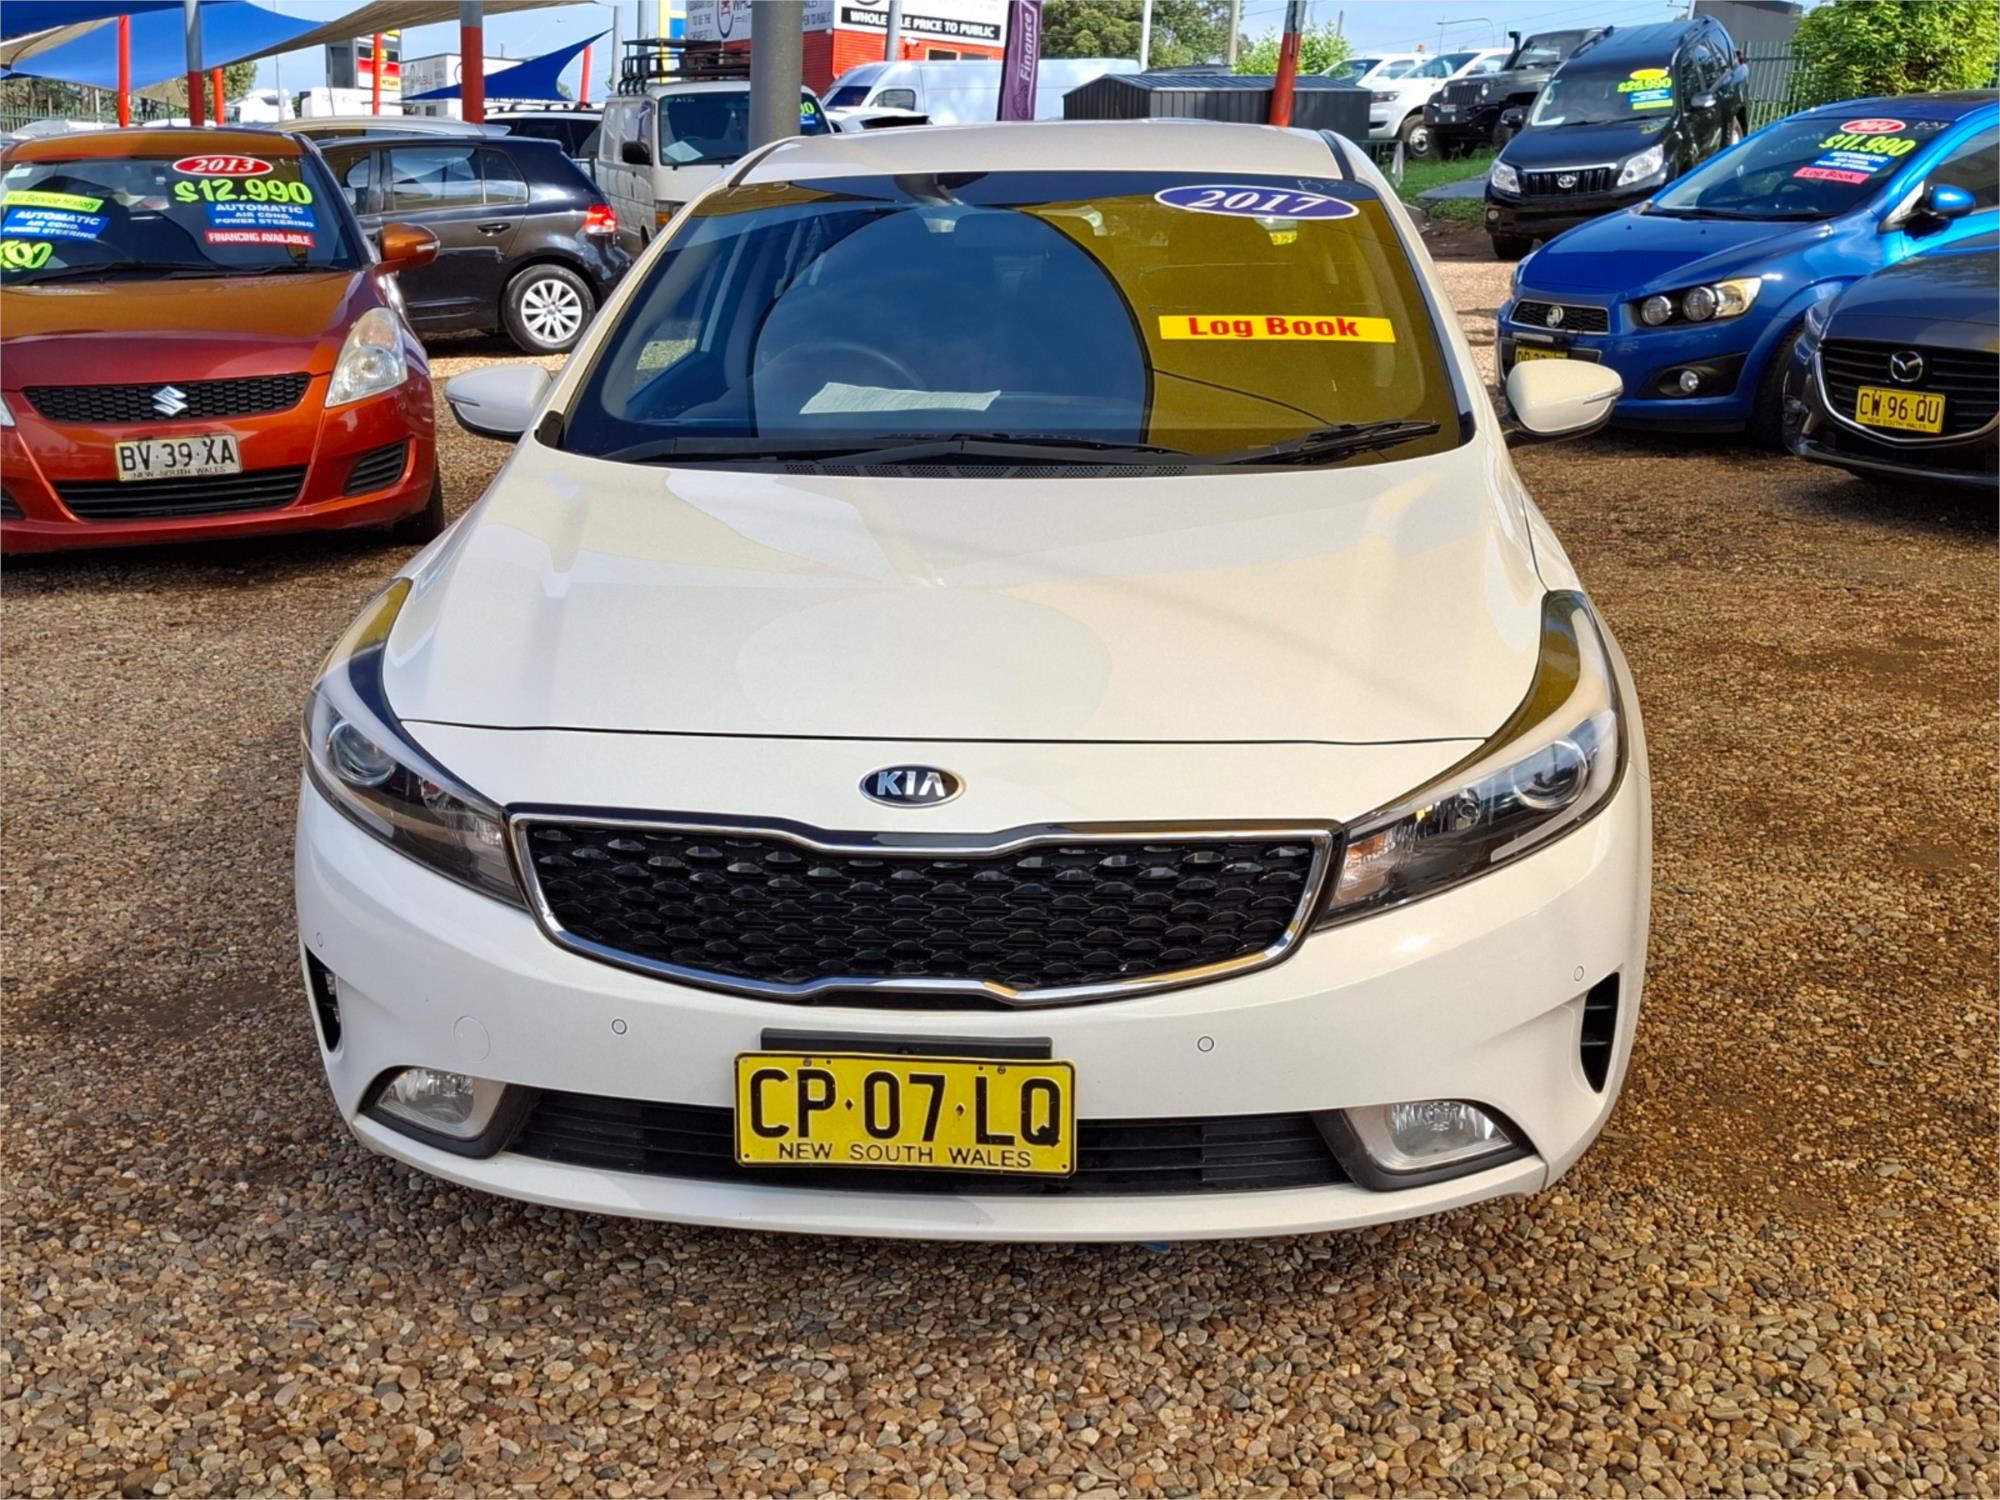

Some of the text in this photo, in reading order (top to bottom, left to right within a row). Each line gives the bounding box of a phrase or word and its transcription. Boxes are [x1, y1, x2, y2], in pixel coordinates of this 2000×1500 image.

[913, 19, 943, 32] PRICE
[944, 22, 958, 33] TO
[960, 24, 995, 38] PUBLIC
[1020, 12, 1033, 81] Finance
[191, 158, 255, 172] 2013
[26, 193, 61, 205] Service
[1187, 190, 1328, 214] 2017
[215, 202, 305, 215] AUTOMATIC
[15, 210, 102, 226] AUTOMATIC
[214, 217, 315, 228] POWER STEERING
[42, 227, 97, 240] STEERING
[208, 231, 313, 247] FINANCING AVAILABLE
[1188, 316, 1360, 338] Log Book
[133, 470, 155, 479] NEW
[195, 466, 227, 474] WALES
[876, 770, 946, 798] KIA
[779, 1143, 1032, 1169] NEW SOUTH WALES
